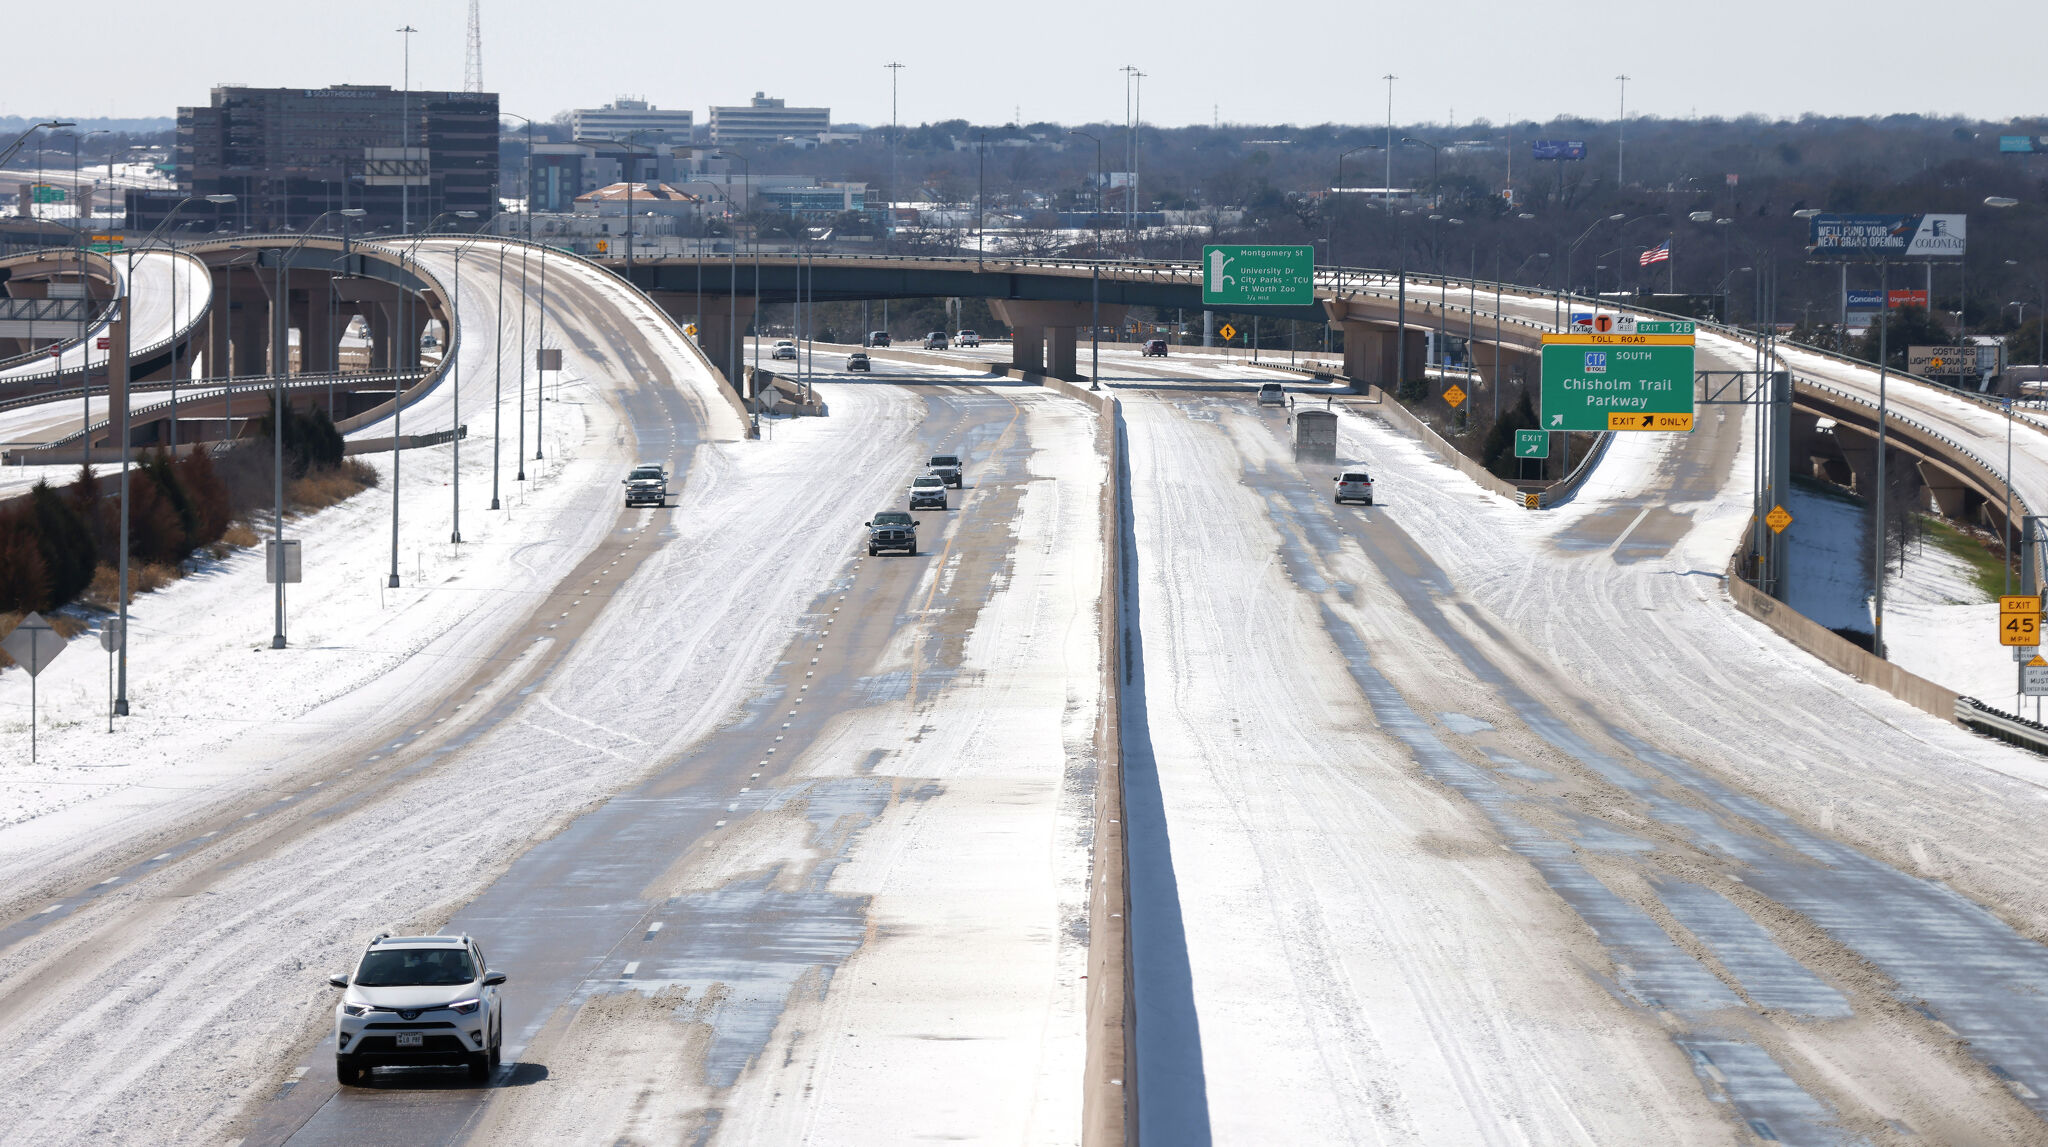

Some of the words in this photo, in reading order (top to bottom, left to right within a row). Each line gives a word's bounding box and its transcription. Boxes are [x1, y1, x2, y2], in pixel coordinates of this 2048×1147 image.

[1866, 226, 1887, 237] YOUR
[1818, 236, 1839, 248] NEXT
[1240, 249, 1292, 258] Montgomery
[1295, 249, 1304, 257] St
[1240, 267, 1282, 276] University
[1240, 276, 1257, 285] City
[1260, 276, 1282, 284] Parks
[1293, 276, 1309, 284] TCU
[1240, 285, 1248, 293] Ft
[1252, 285, 1277, 293] Worth
[1280, 285, 1296, 293] Zoo
[1597, 317, 1609, 332] T
[1617, 316, 1634, 324] Zip
[1572, 325, 1593, 334] TxTag
[1640, 323, 1660, 332] EXIT
[1669, 322, 1692, 333] 12B
[1591, 335, 1614, 343] TOLL
[1621, 335, 1647, 343] ROAD
[1586, 353, 1605, 366] CTP
[1616, 351, 1652, 361] SOUTH
[1563, 378, 1632, 391] Chisholm
[1639, 378, 1673, 391] Trail
[1586, 395, 1649, 409] Parkway
[1612, 417, 1636, 426] EXIT
[1660, 417, 1689, 427] ONLY
[1521, 434, 1543, 442] EXIT
[2008, 601, 2032, 609] EXIT
[2006, 617, 2034, 633] 45
